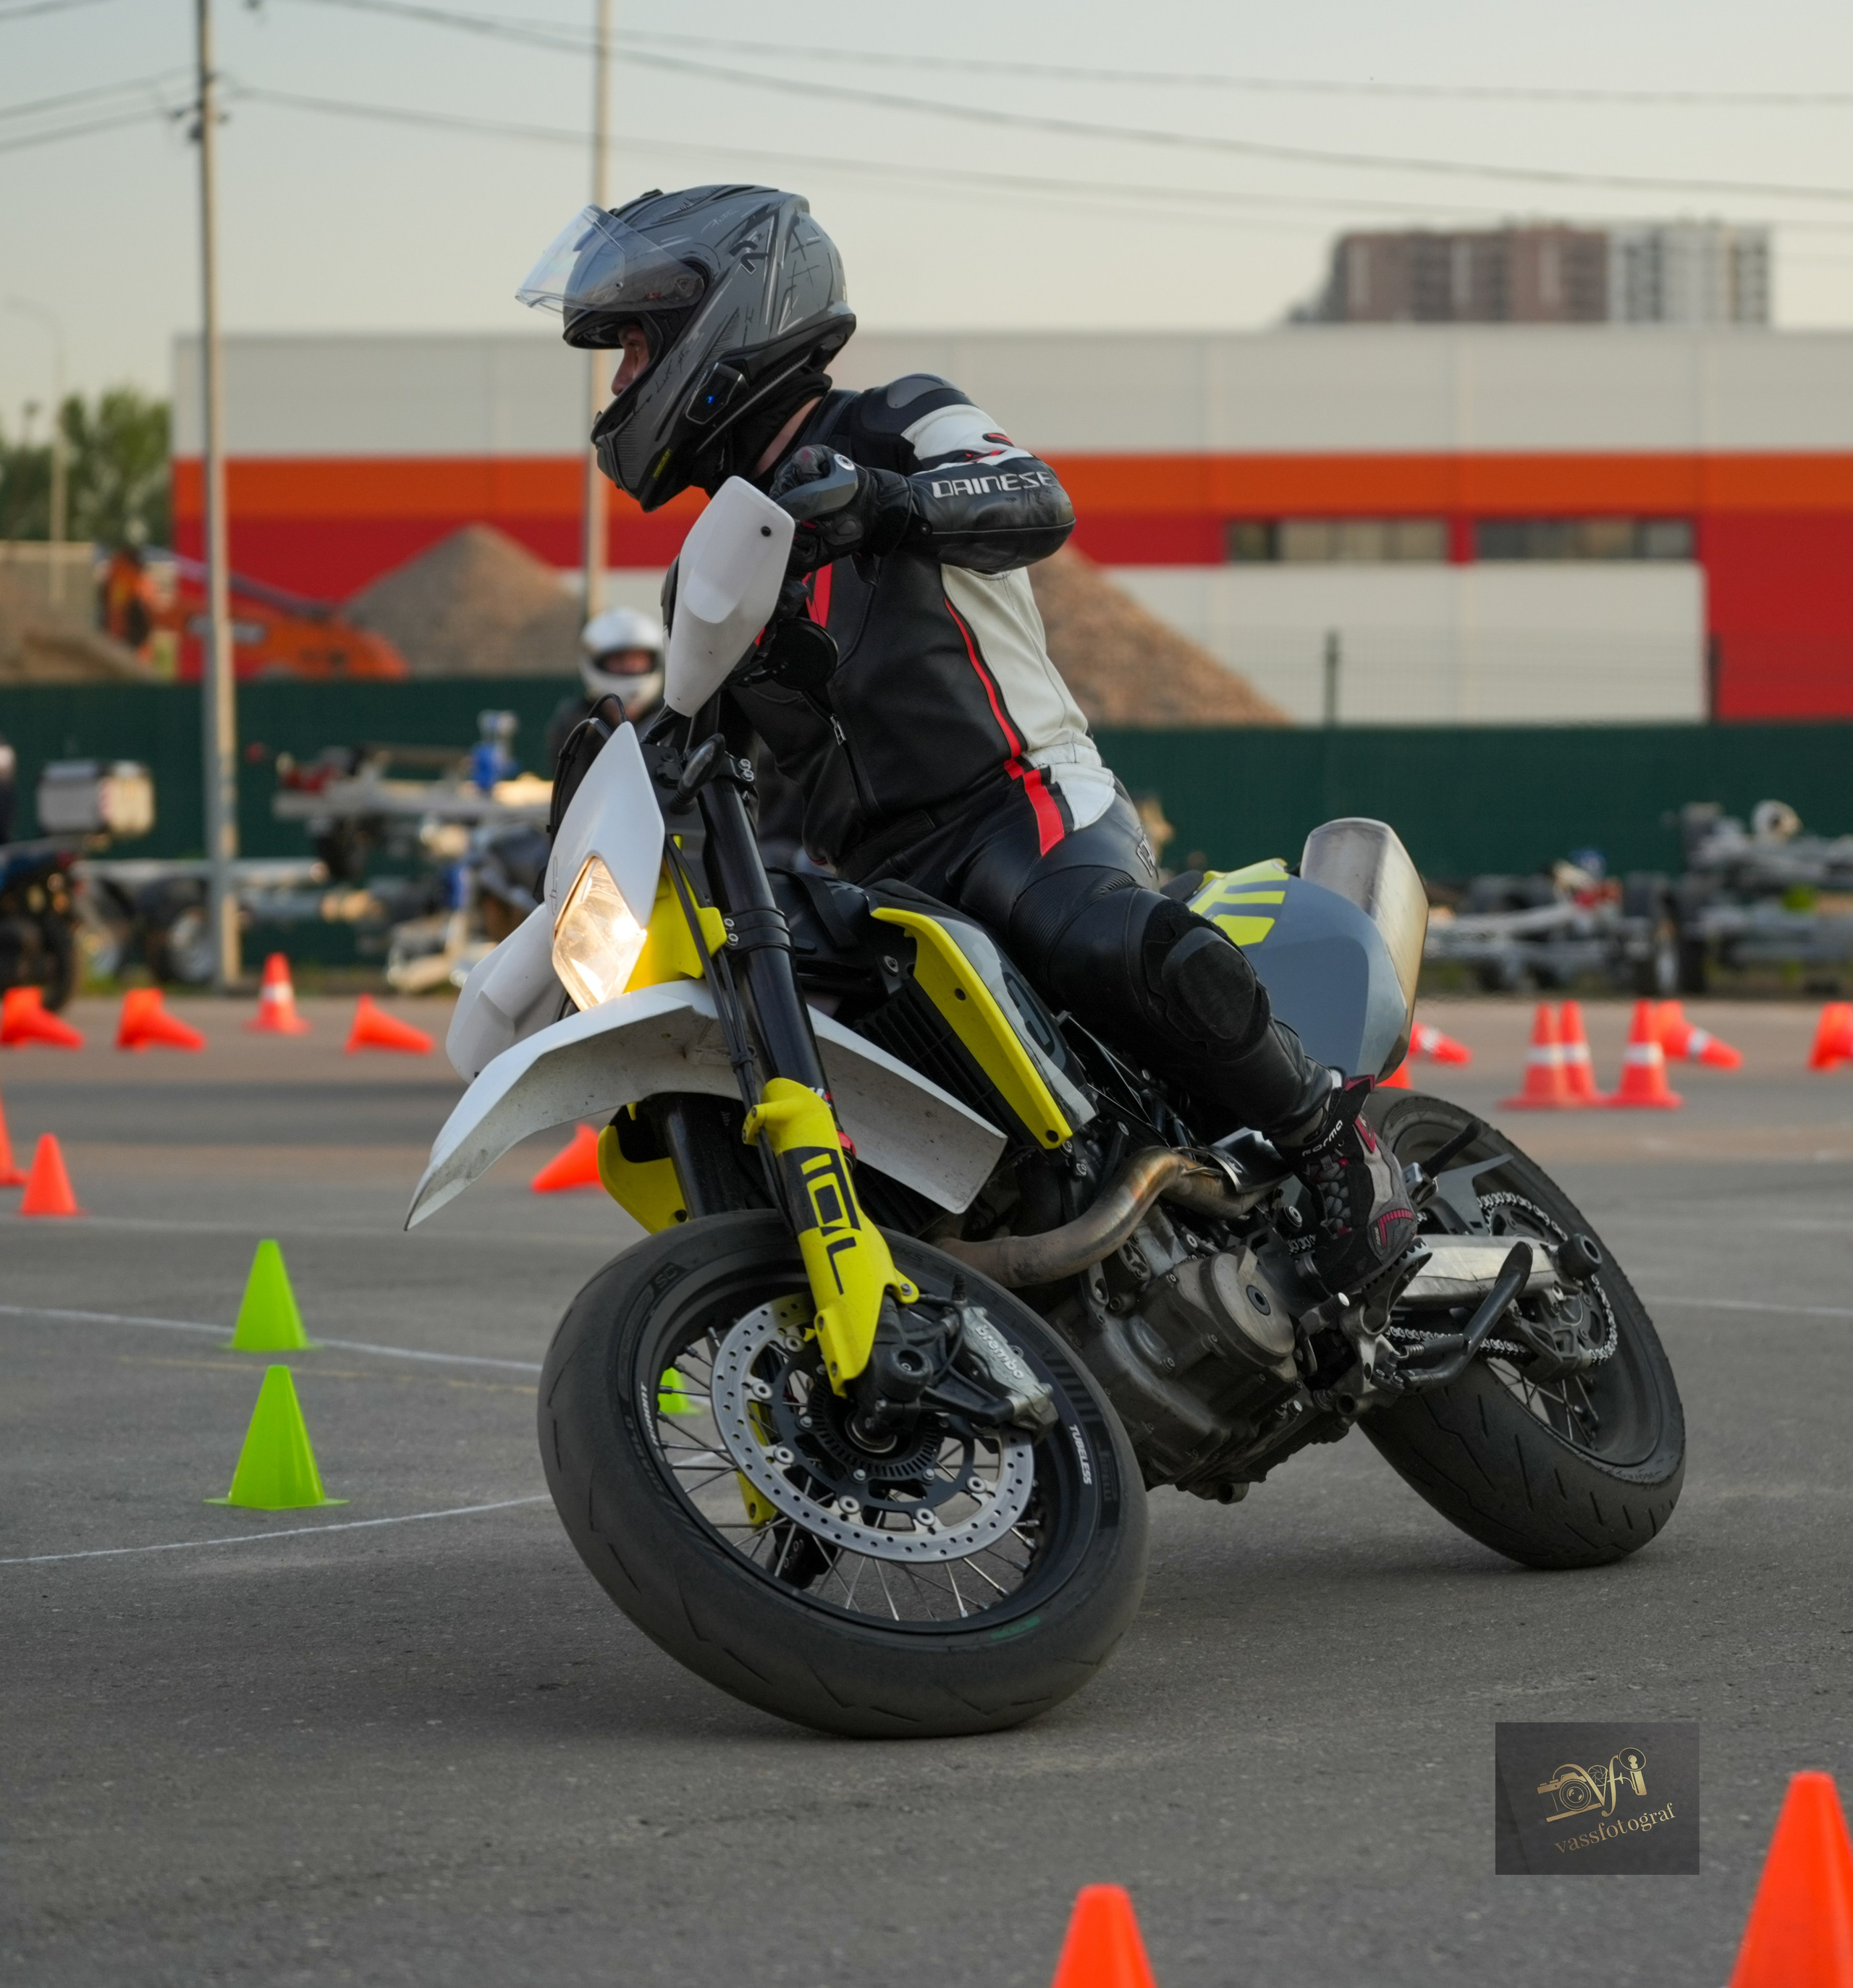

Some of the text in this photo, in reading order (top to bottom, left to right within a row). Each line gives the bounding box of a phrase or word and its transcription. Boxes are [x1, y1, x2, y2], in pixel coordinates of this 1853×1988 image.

[931, 471, 1058, 499] DAINESE
[974, 1324, 1025, 1379] brembo
[1068, 1424, 1092, 1486] TUBELESS
